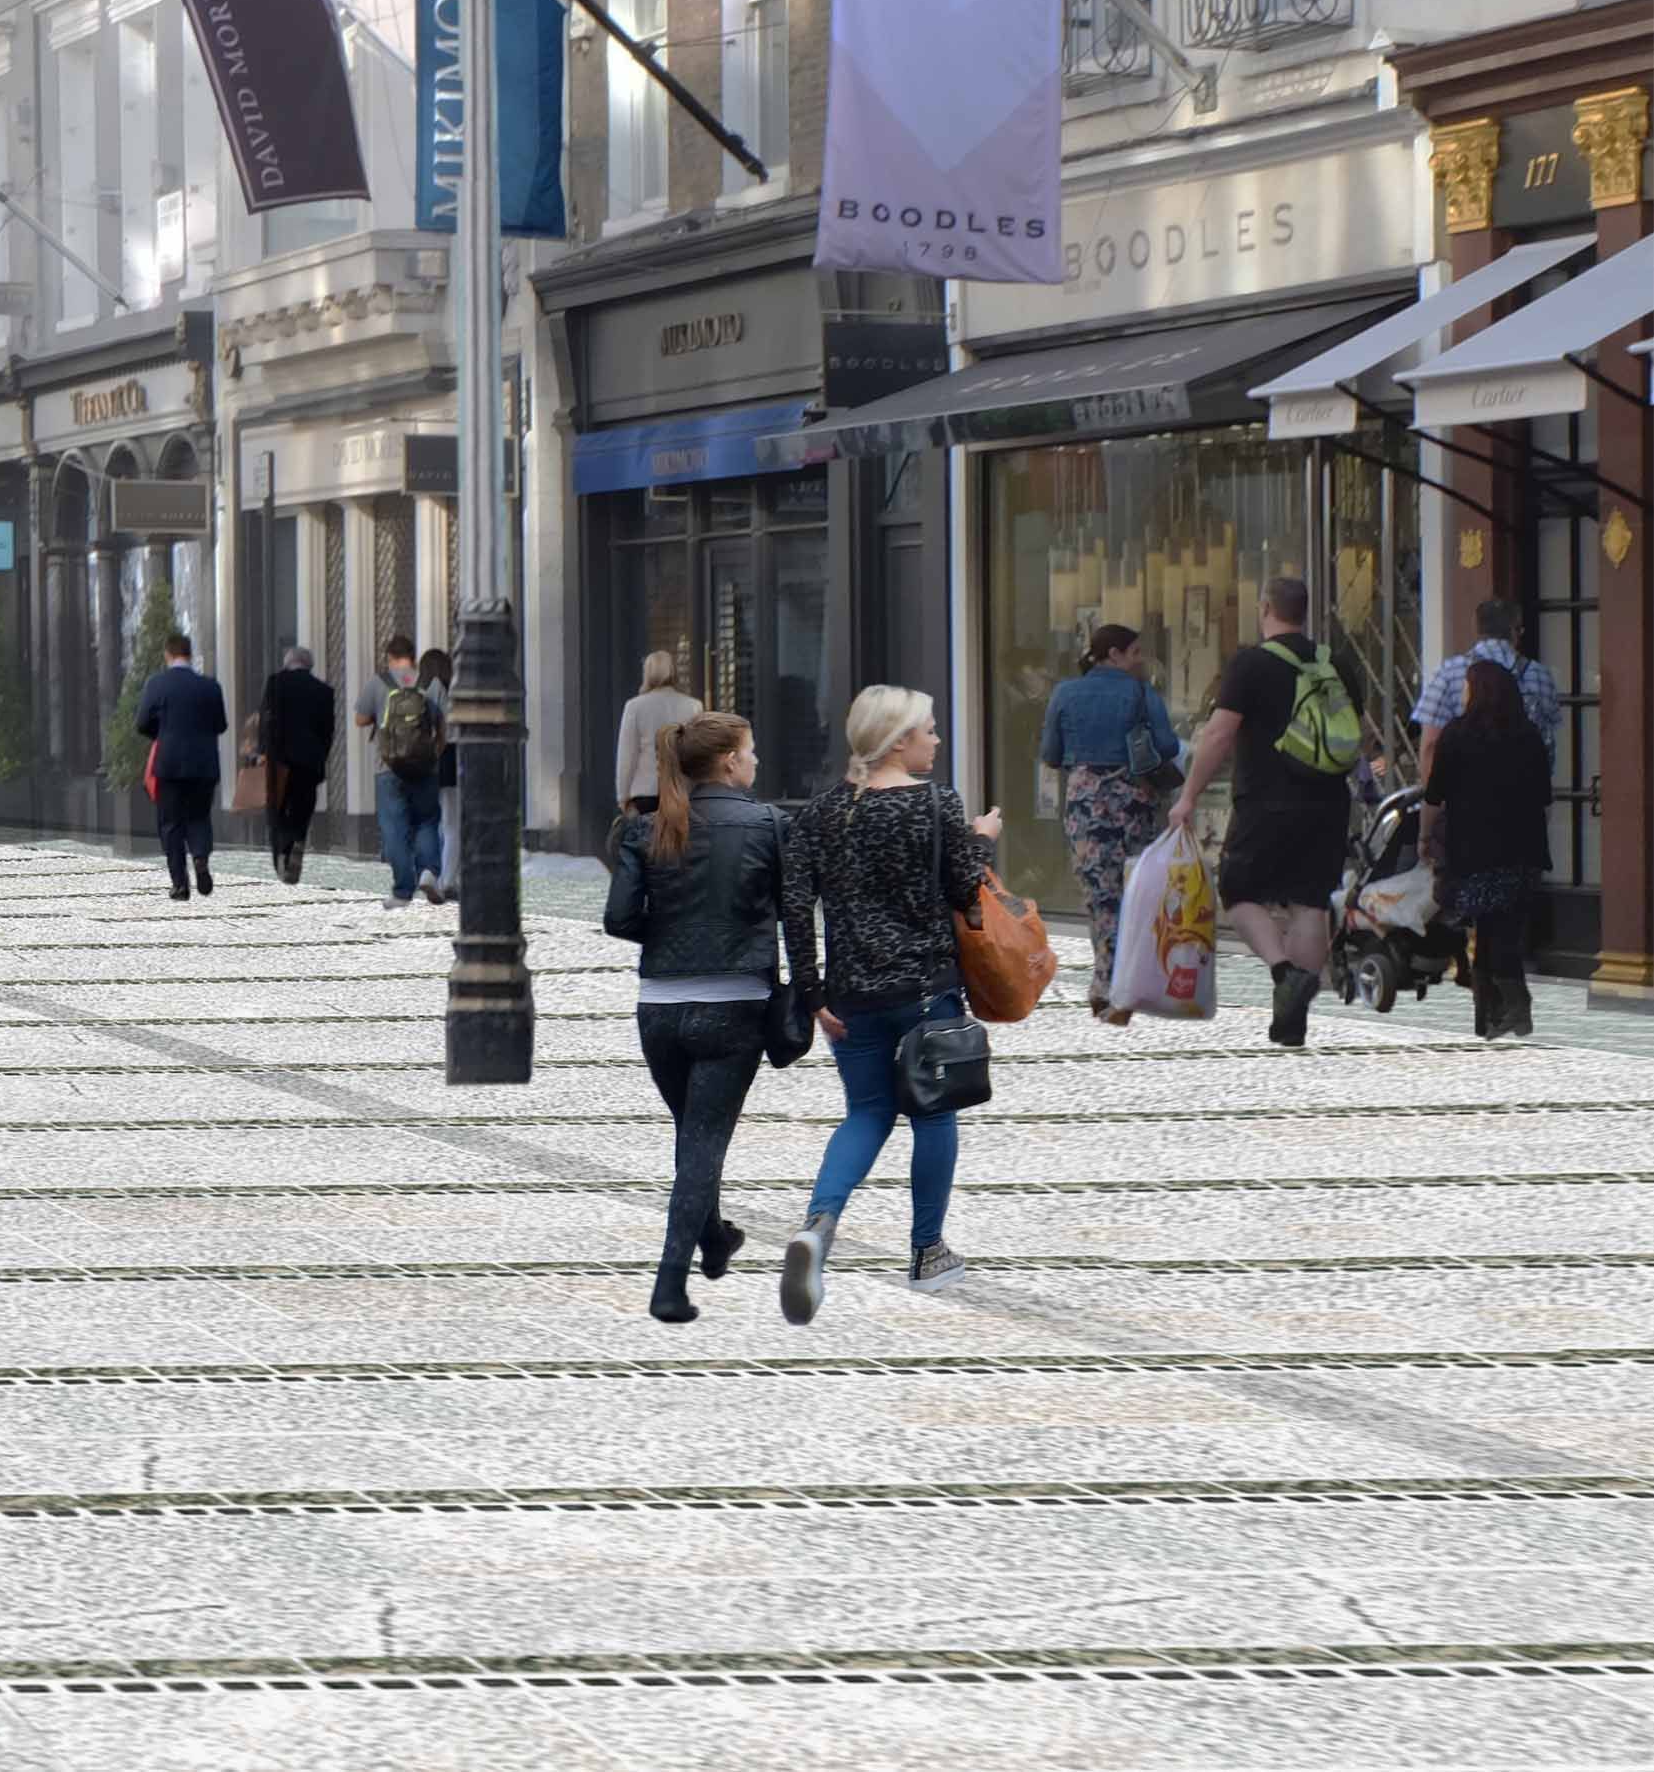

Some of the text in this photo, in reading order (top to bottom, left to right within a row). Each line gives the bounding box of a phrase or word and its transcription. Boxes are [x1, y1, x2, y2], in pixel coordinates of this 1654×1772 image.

[237, 88, 284, 189] DAVID
[1525, 153, 1559, 189] 177
[838, 199, 1046, 239] BOODLES
[902, 240, 978, 261] 1798
[1064, 203, 1293, 283] BOODLES
